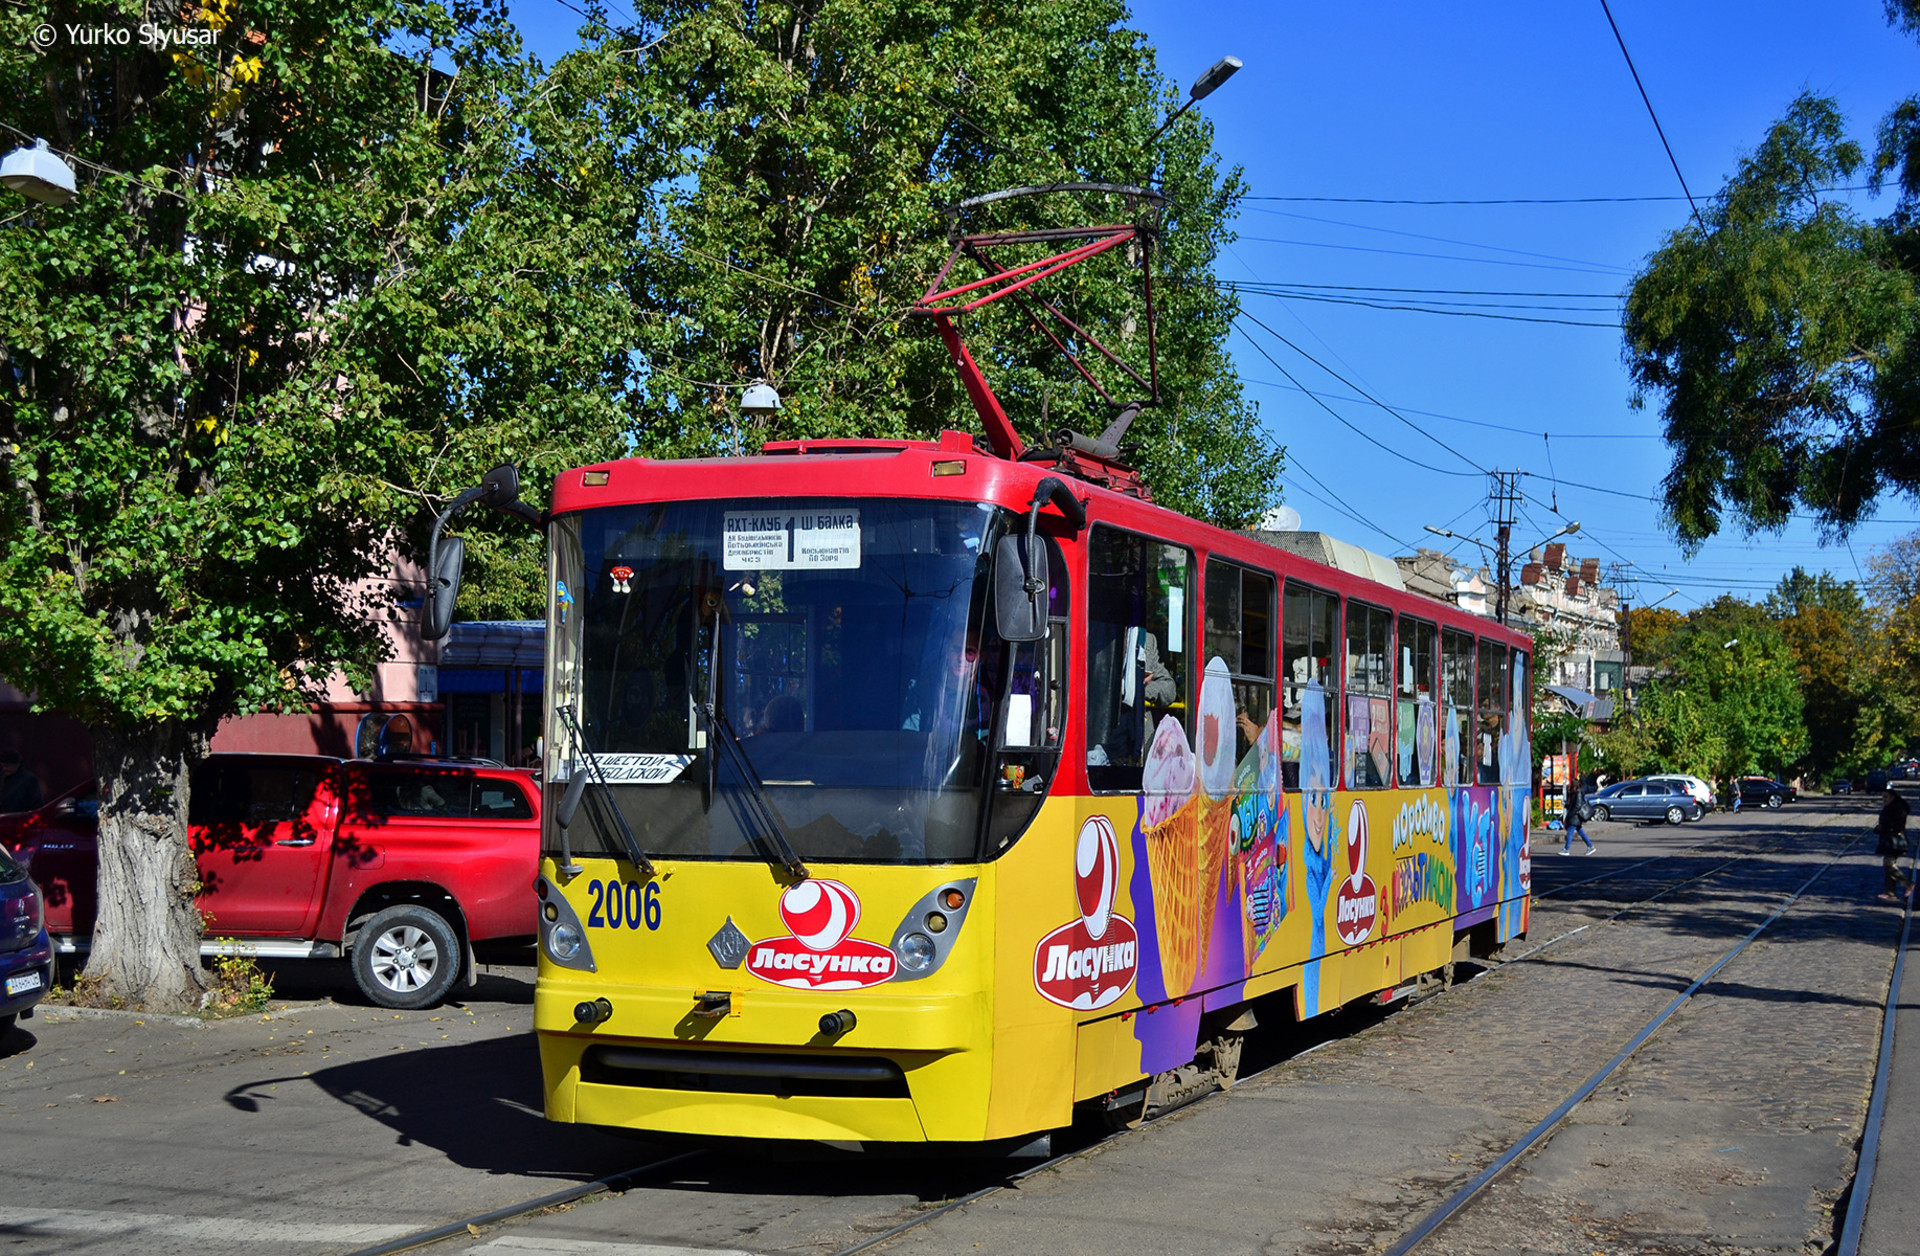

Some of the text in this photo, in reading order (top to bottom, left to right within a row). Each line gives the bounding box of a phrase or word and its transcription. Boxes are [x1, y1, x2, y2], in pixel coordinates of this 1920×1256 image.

[727, 517, 781, 533] ЯХТ-КЛУБ
[785, 517, 795, 562] 1
[602, 755, 667, 767] ШЕСТОЙ
[587, 879, 661, 931] 2006
[1338, 895, 1376, 924] Ласунка
[752, 948, 892, 975] Ласунка
[1041, 940, 1136, 983] Ласунка
